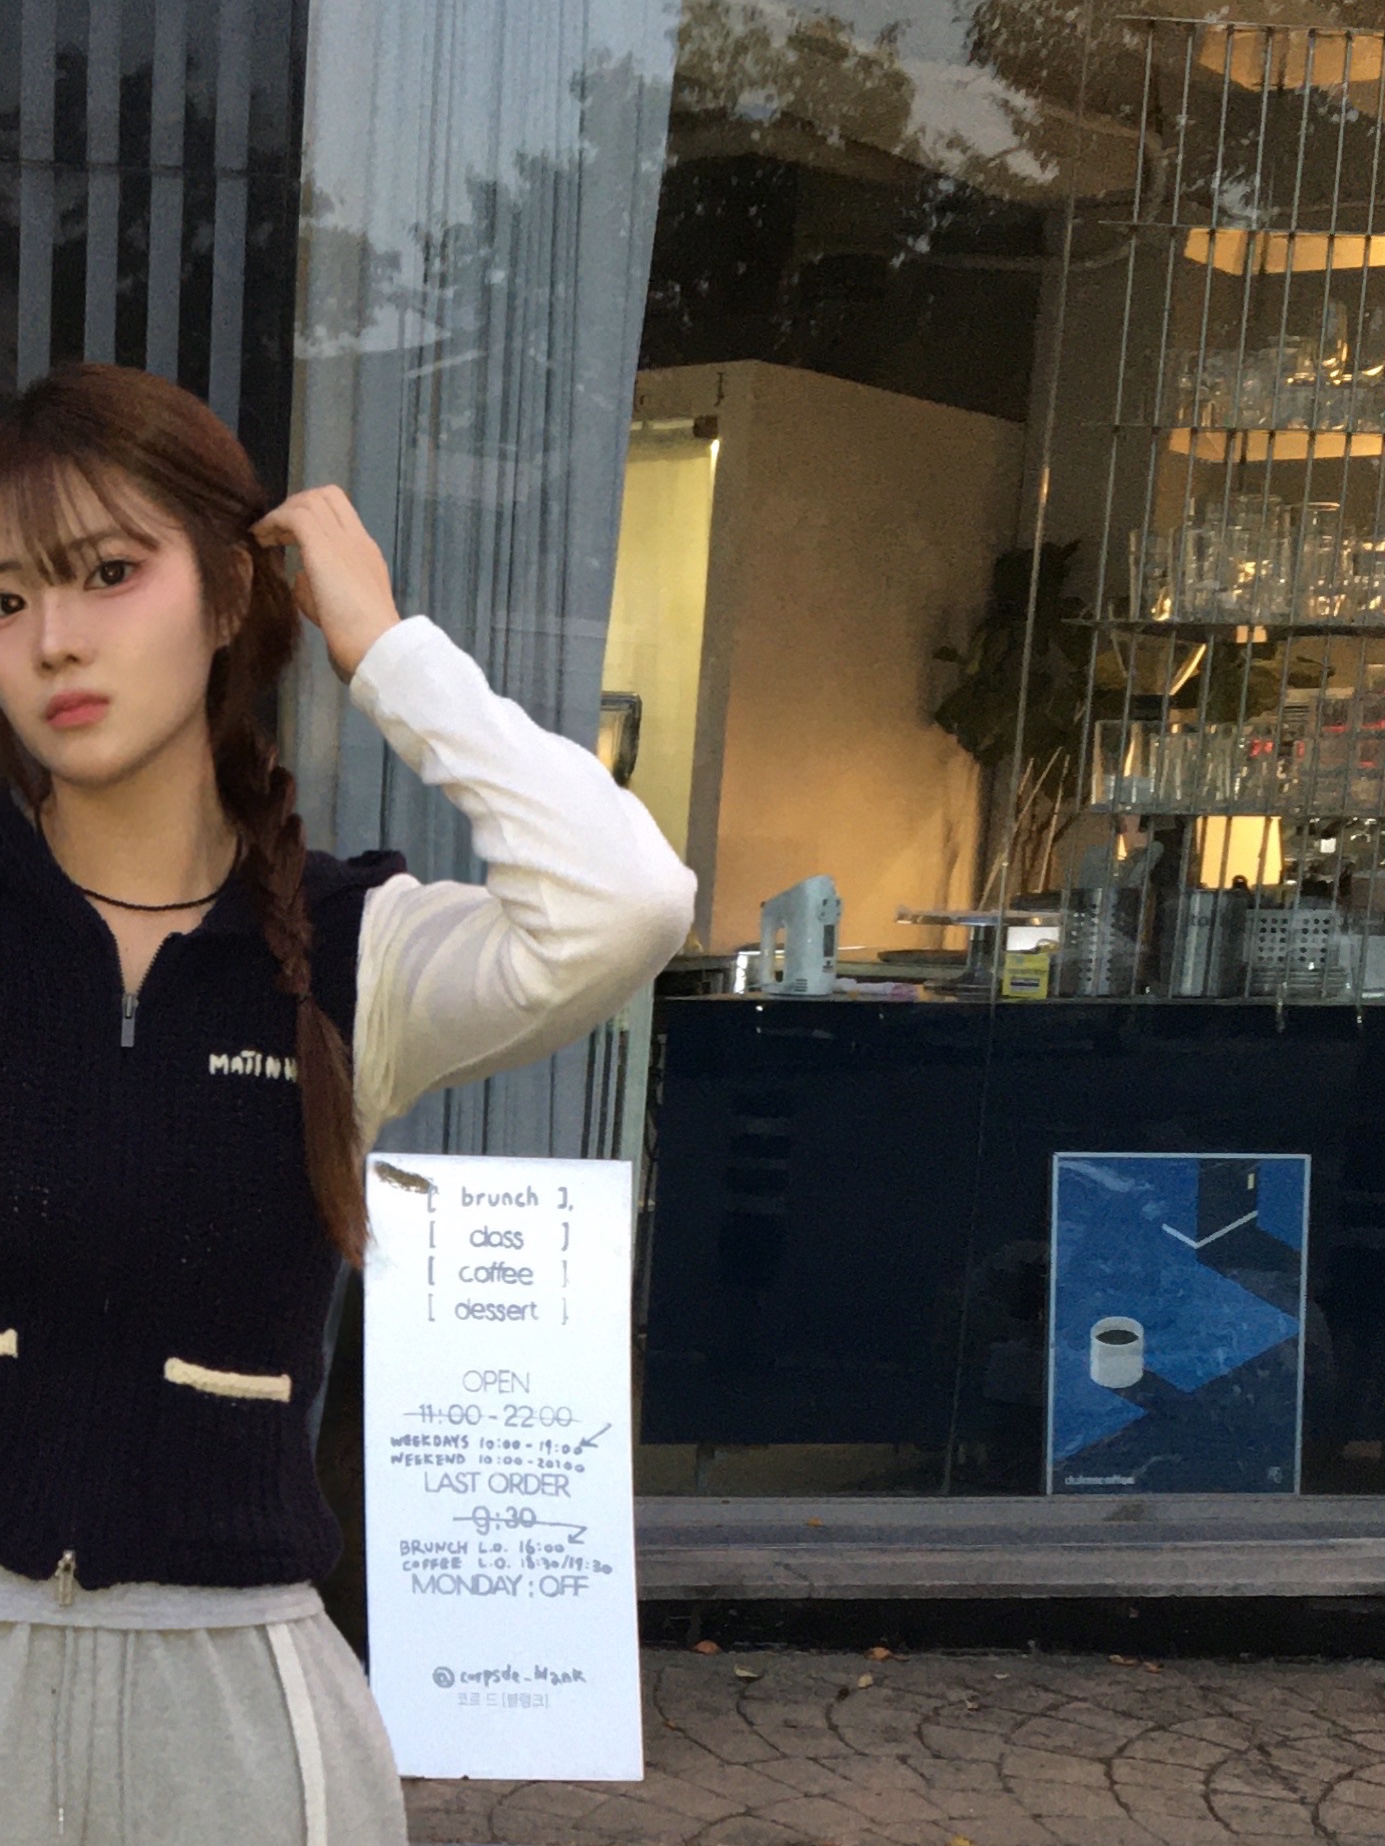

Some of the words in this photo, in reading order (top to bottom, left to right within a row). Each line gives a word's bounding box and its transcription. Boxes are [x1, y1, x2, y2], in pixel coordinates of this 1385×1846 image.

[462, 1186, 538, 1207] brunch
[469, 1225, 524, 1250] class
[459, 1261, 533, 1285] coffee
[455, 1299, 538, 1322] dessert
[463, 1369, 529, 1394] OPEN
[391, 1434, 469, 1450] WEEKDAYS
[480, 1437, 520, 1450] 10:00
[391, 1452, 465, 1466] WEEKEND
[425, 1472, 481, 1494] LAST
[488, 1473, 571, 1497] ORDER
[400, 1540, 467, 1555] BRUNCH
[520, 1539, 565, 1557] 16:00
[403, 1557, 461, 1571] COFFEE
[412, 1574, 522, 1596] MONDAY
[539, 1575, 588, 1597] OFF
